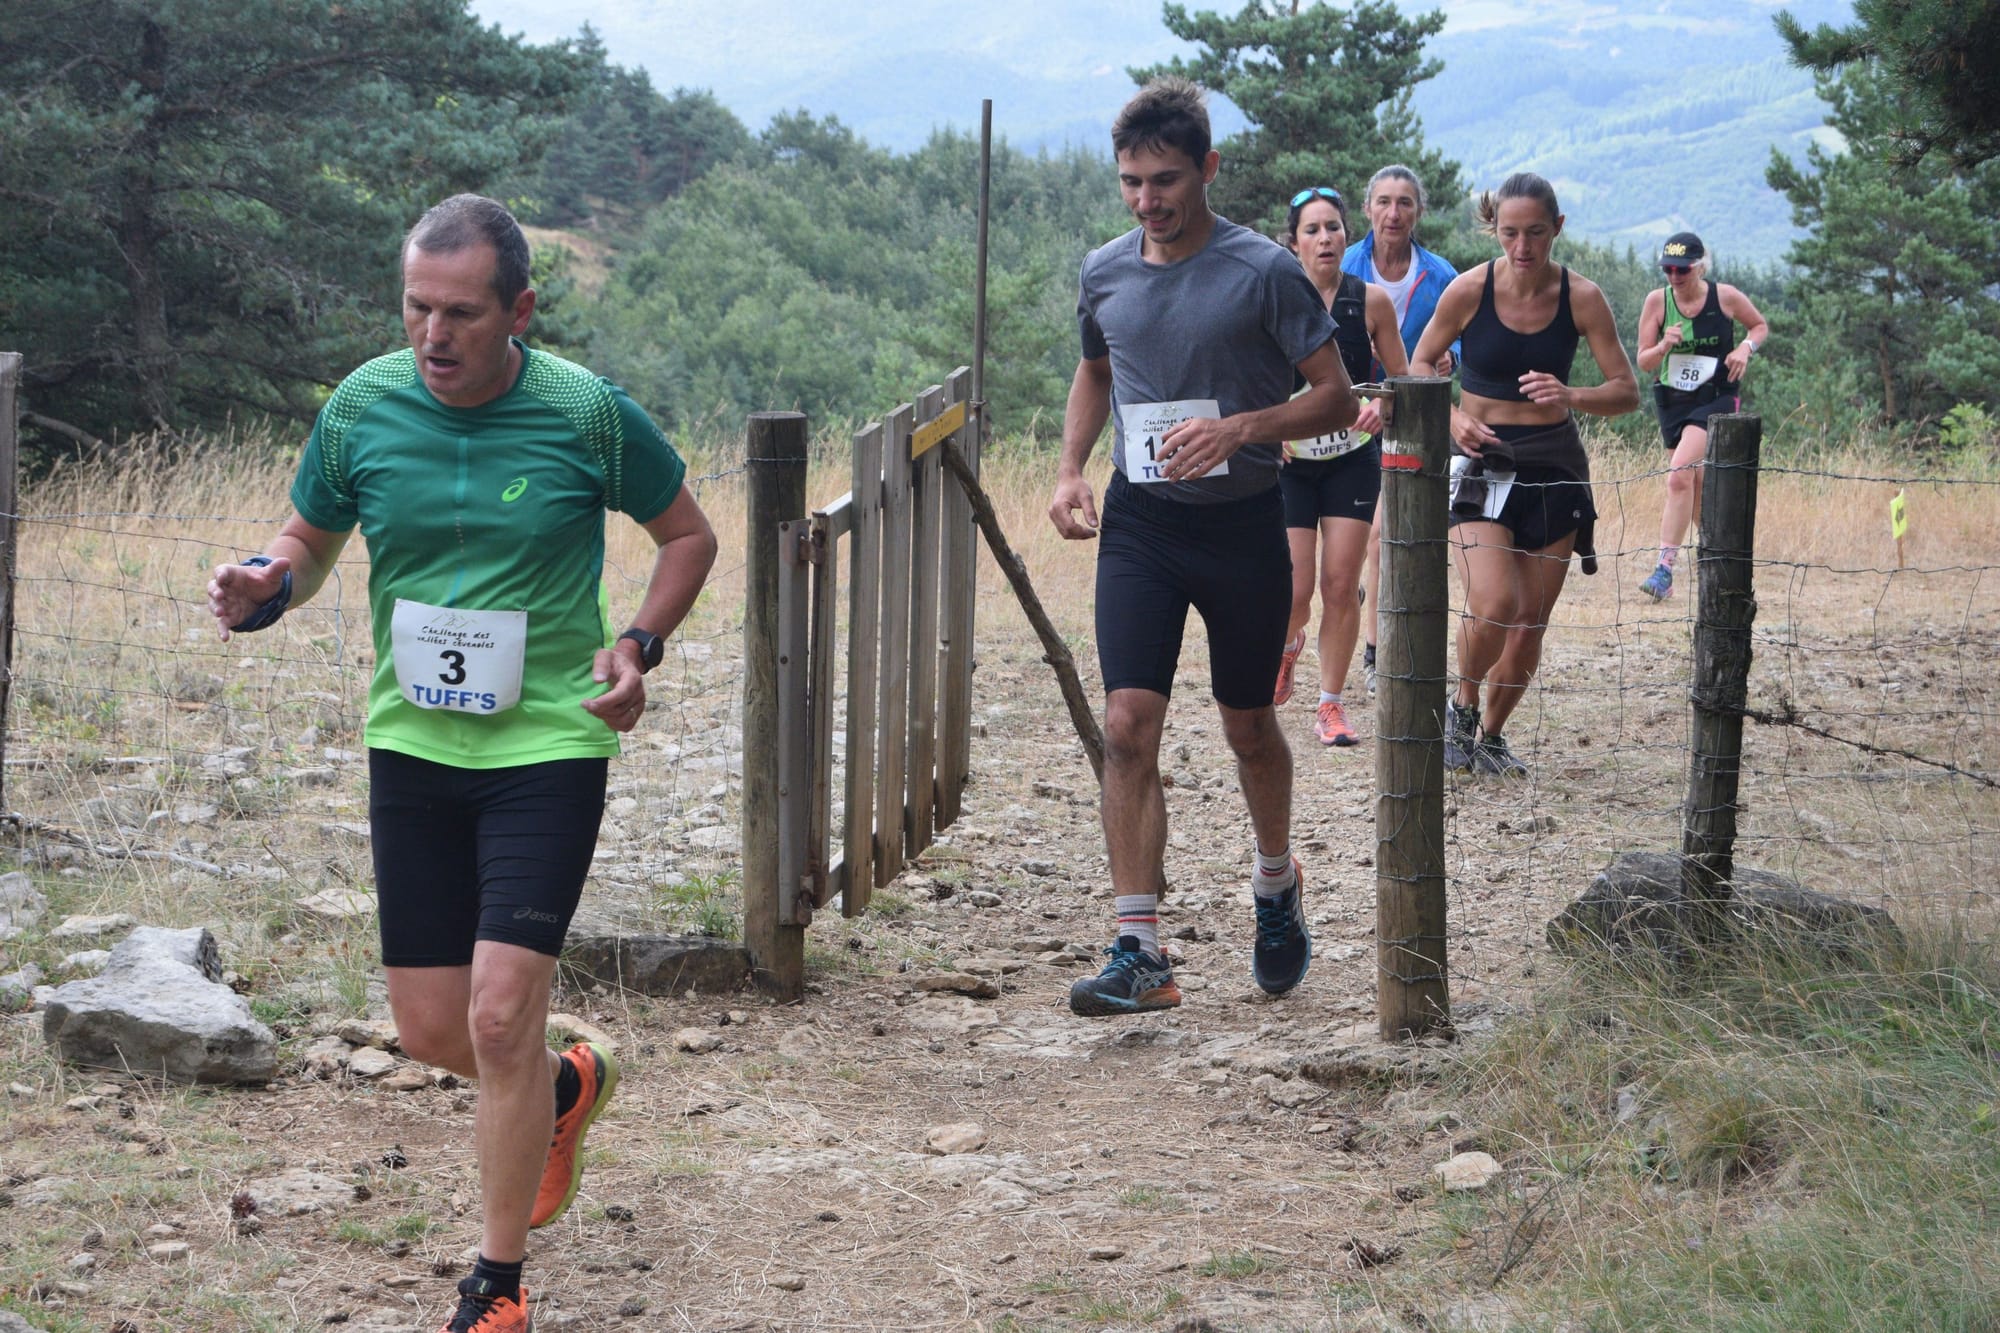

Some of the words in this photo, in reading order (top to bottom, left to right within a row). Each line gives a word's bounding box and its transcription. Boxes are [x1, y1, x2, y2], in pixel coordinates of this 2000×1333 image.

[1681, 368, 1700, 382] 58
[1311, 441, 1352, 457] TUFF'S
[417, 636, 447, 645] vallées
[422, 625, 467, 643] Challenge
[473, 631, 491, 640] des
[438, 649, 467, 686] 3
[412, 683, 497, 711] TUFF'S
